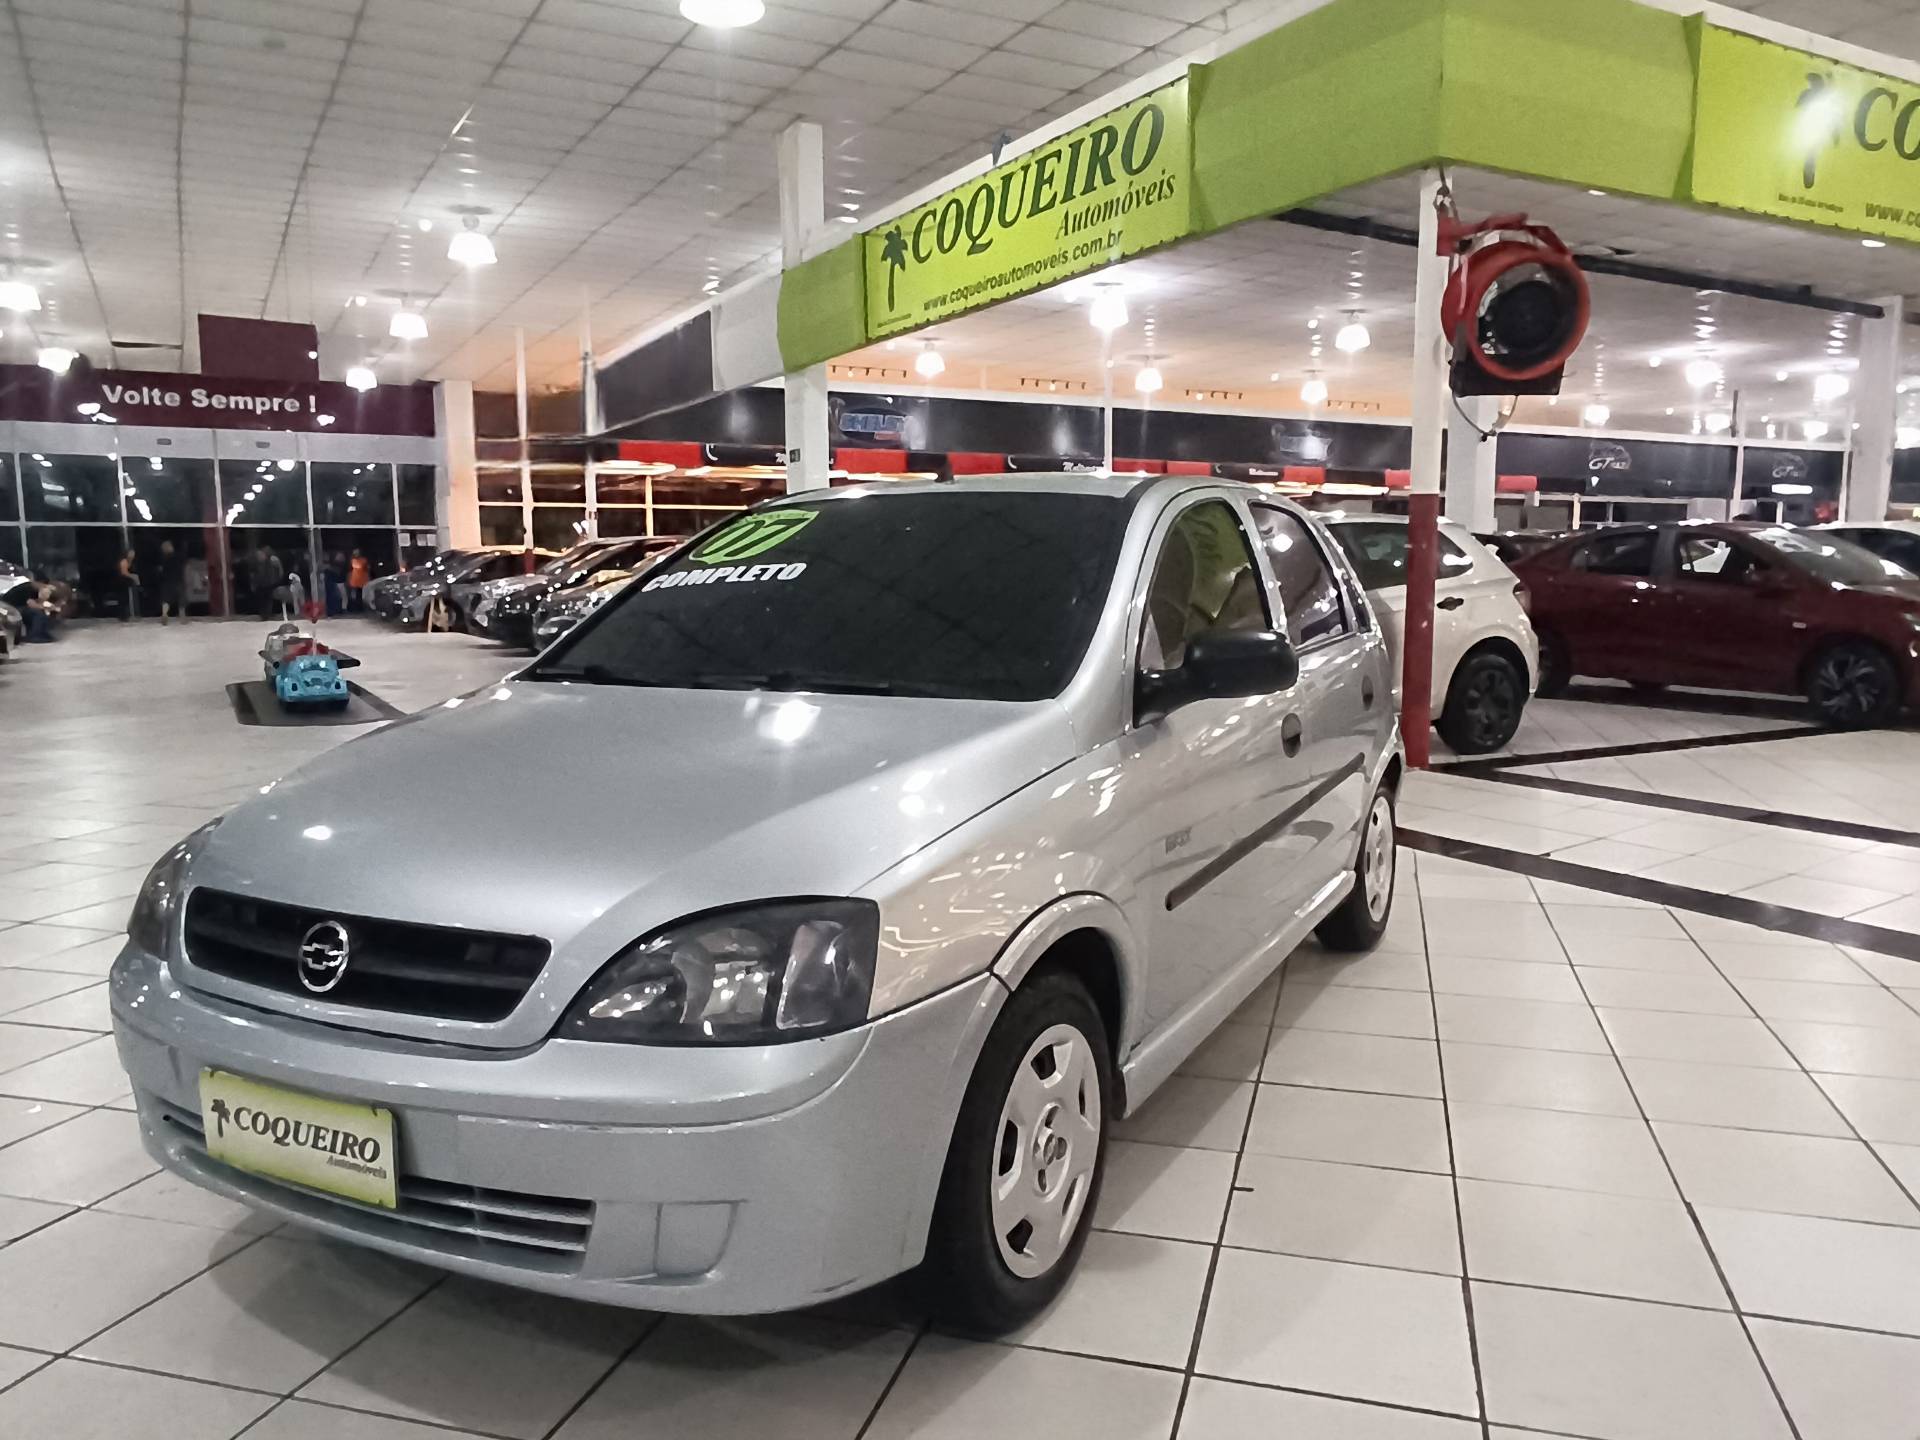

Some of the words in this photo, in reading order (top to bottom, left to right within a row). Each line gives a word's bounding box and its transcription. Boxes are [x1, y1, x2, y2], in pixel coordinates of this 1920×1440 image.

[911, 103, 1166, 264] COQUEIRO
[1056, 169, 1176, 239] Automóveis
[922, 228, 1124, 312] www.coqueiroautomoveis.com.br
[101, 384, 181, 407] Volte
[191, 388, 300, 415] Sempre
[693, 517, 809, 557] 07
[641, 562, 808, 593] COMPLETO
[233, 1106, 381, 1163] COQUEIRO
